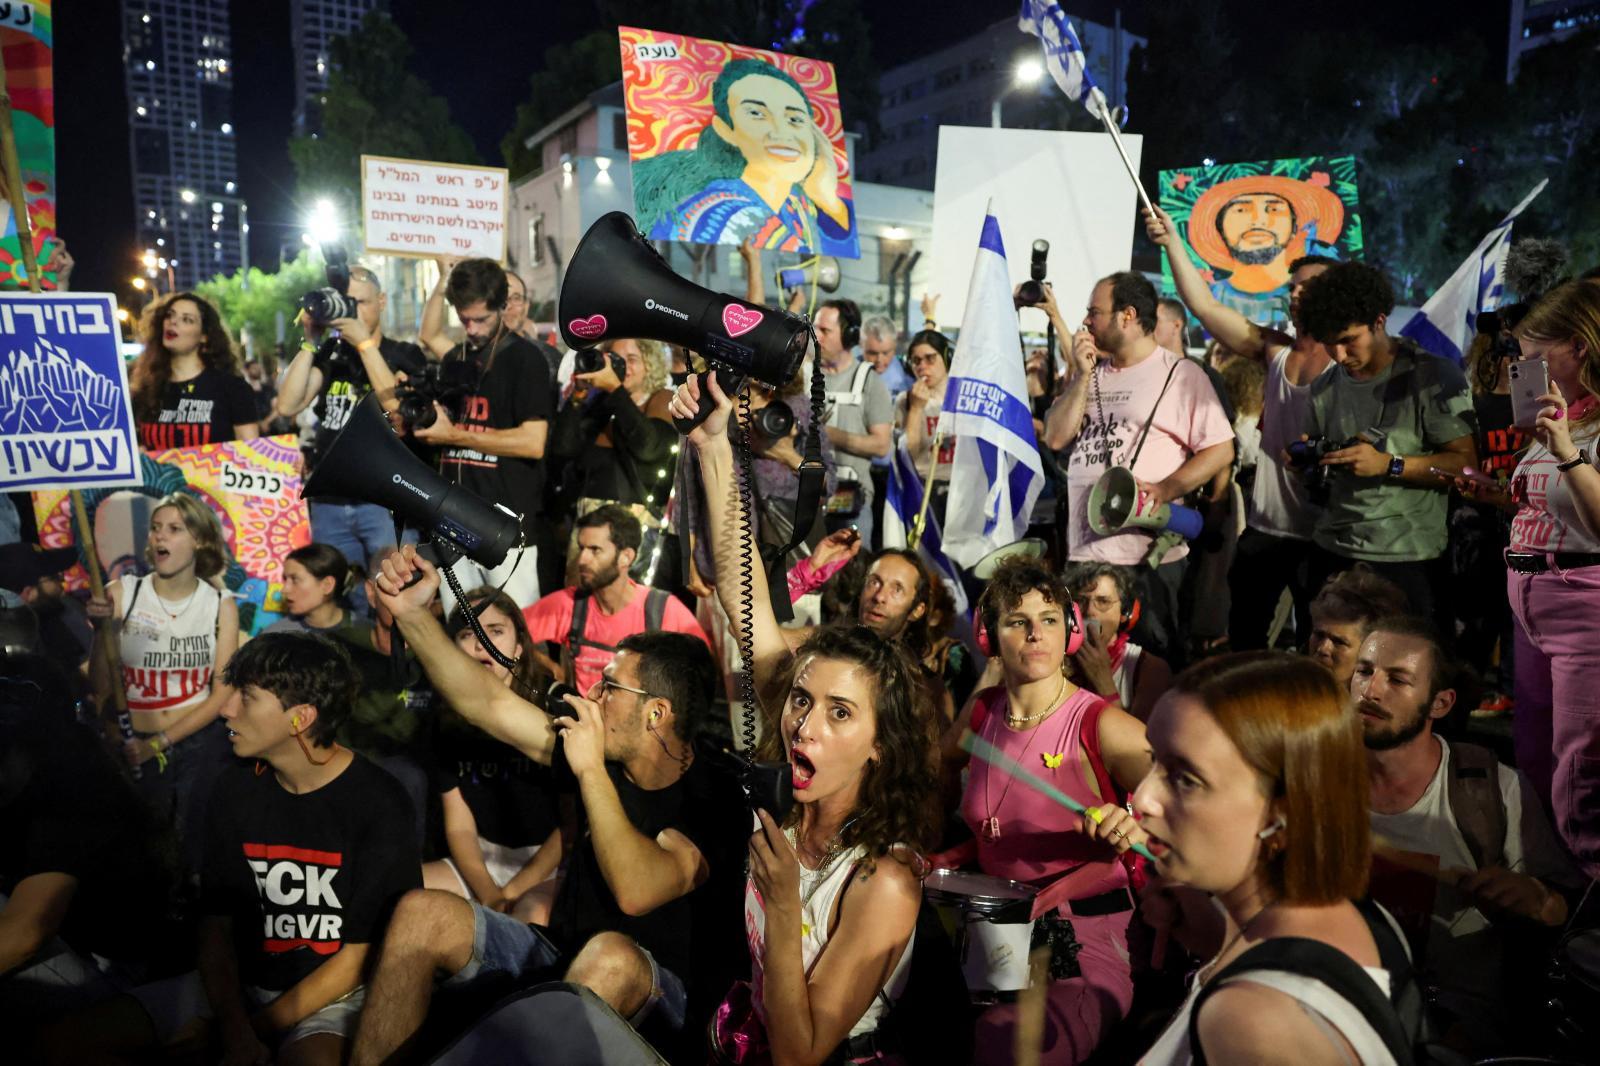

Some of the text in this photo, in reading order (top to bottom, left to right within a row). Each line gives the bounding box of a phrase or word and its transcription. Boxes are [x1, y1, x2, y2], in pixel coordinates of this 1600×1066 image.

[638, 46, 676, 59] נועה
[436, 174, 464, 186] ראש
[373, 190, 499, 211] מיטב בנותינו ובנינו
[437, 214, 464, 227] לשם
[452, 237, 472, 248] עוד
[0, 304, 110, 334] בחירו
[655, 303, 689, 321] PROXTONE
[2, 436, 118, 475] עכשיו!
[224, 464, 281, 493] כרמל
[400, 479, 431, 500] PROXTONE
[144, 652, 181, 668] הביתה
